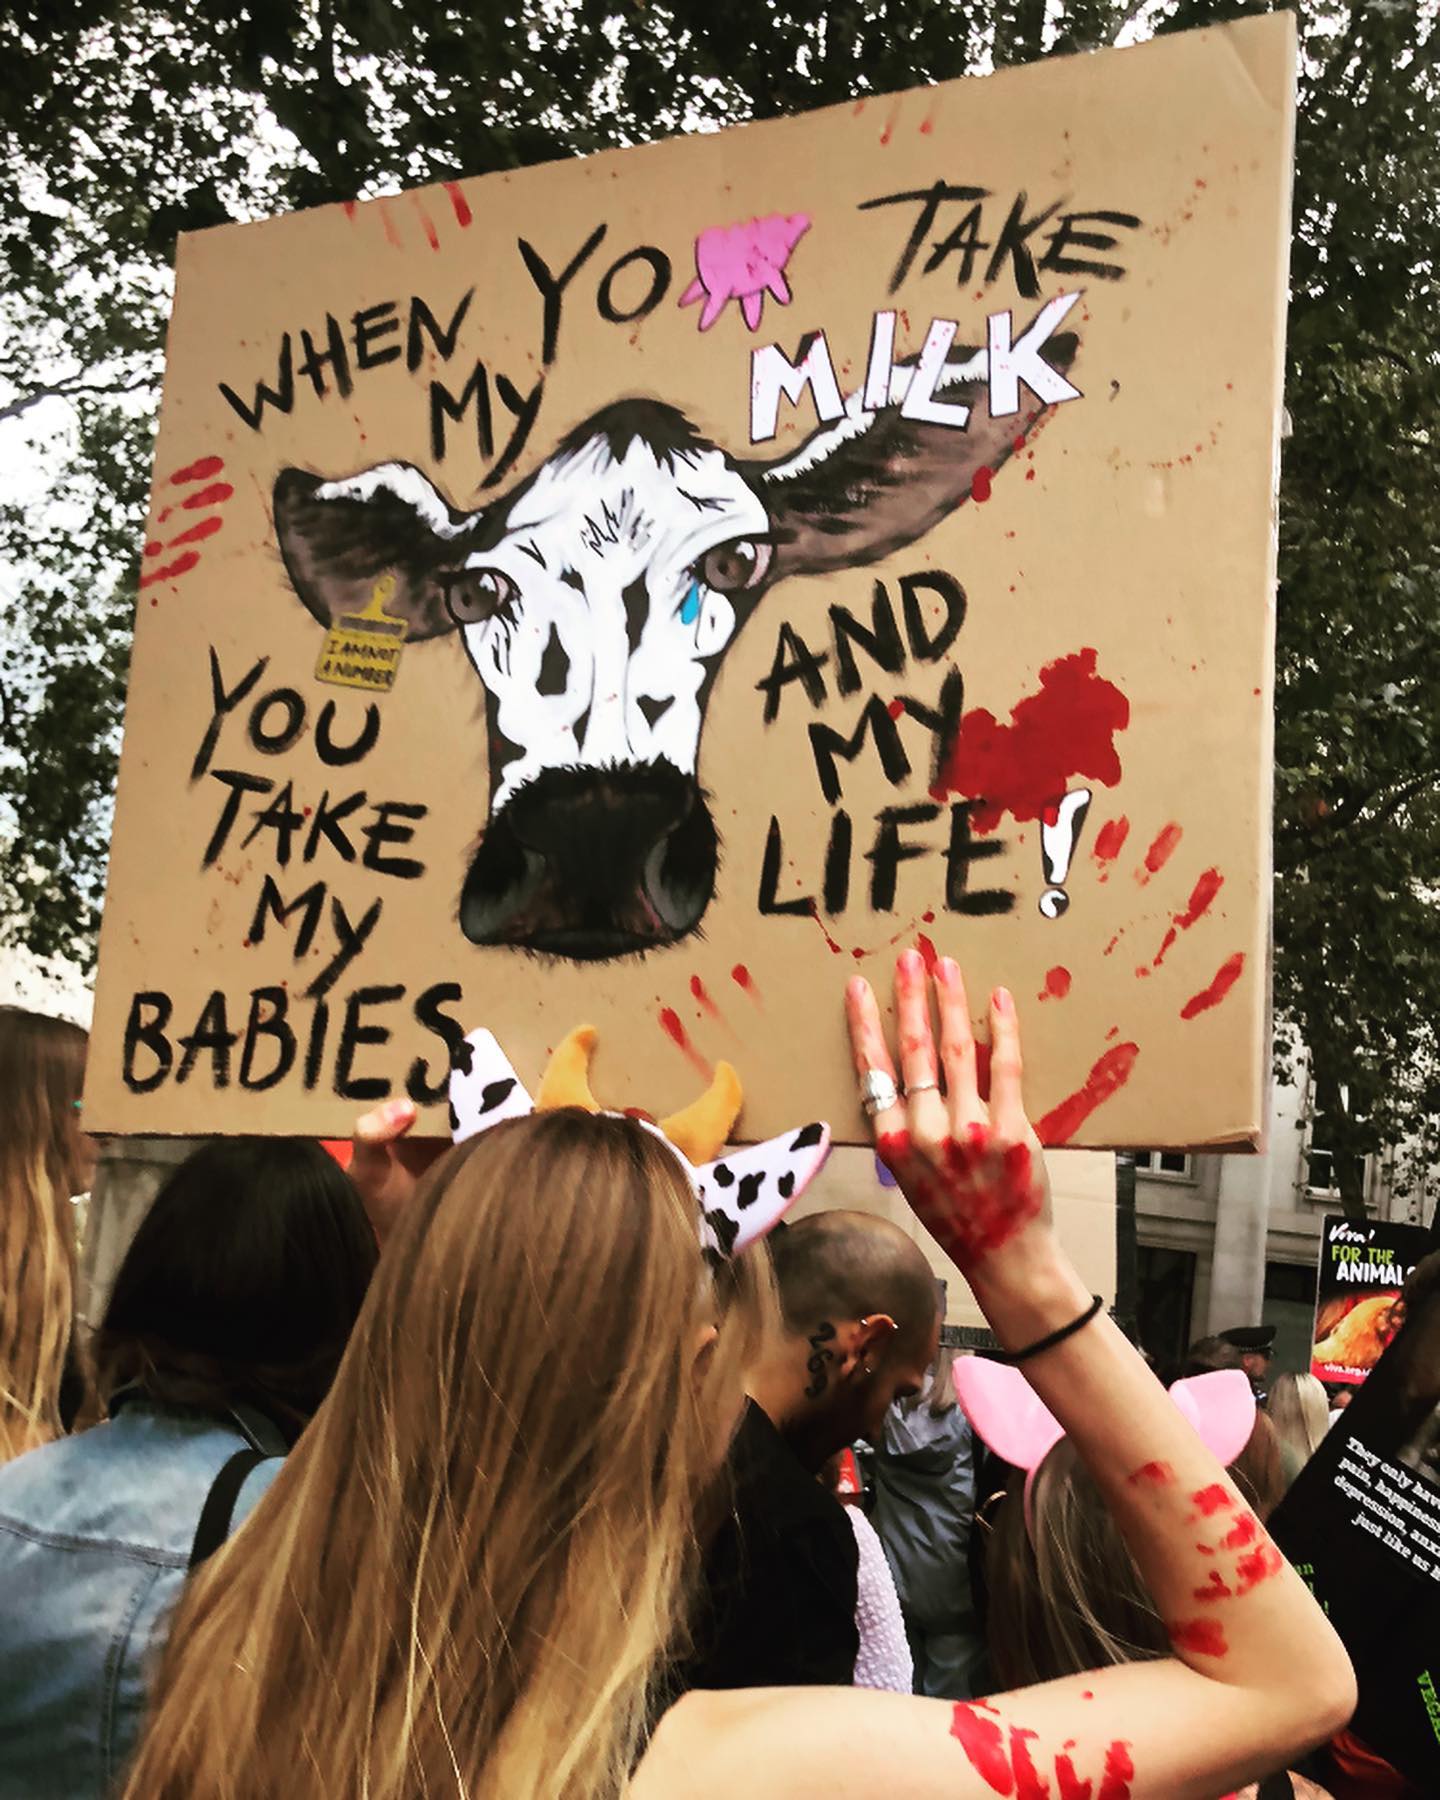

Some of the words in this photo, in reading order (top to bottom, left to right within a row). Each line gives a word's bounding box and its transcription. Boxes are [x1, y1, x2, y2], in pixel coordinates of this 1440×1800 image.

[218, 287, 475, 432] WHEN
[858, 180, 1142, 298] TAKE
[430, 359, 544, 491] MY
[750, 289, 1086, 444] MILK
[755, 570, 968, 725] AND
[189, 645, 381, 788] YOU
[808, 664, 965, 805] MY
[203, 769, 428, 879] TAKE
[757, 789, 1092, 919] LIFE!
[247, 874, 384, 999] MY
[122, 981, 467, 1107] BABIES
[1329, 1222, 1375, 1243] Viva!
[1332, 1245, 1361, 1264] FOR
[1368, 1247, 1395, 1265] THE
[1334, 1475, 1407, 1536] depression,
[1338, 1457, 1372, 1489] pain,
[1374, 1479, 1440, 1533] happiness
[1346, 1436, 1382, 1468] They
[1380, 1462, 1414, 1489] only
[1351, 1511, 1383, 1539] just
[1382, 1531, 1412, 1558] like
[1411, 1553, 1432, 1572] us
